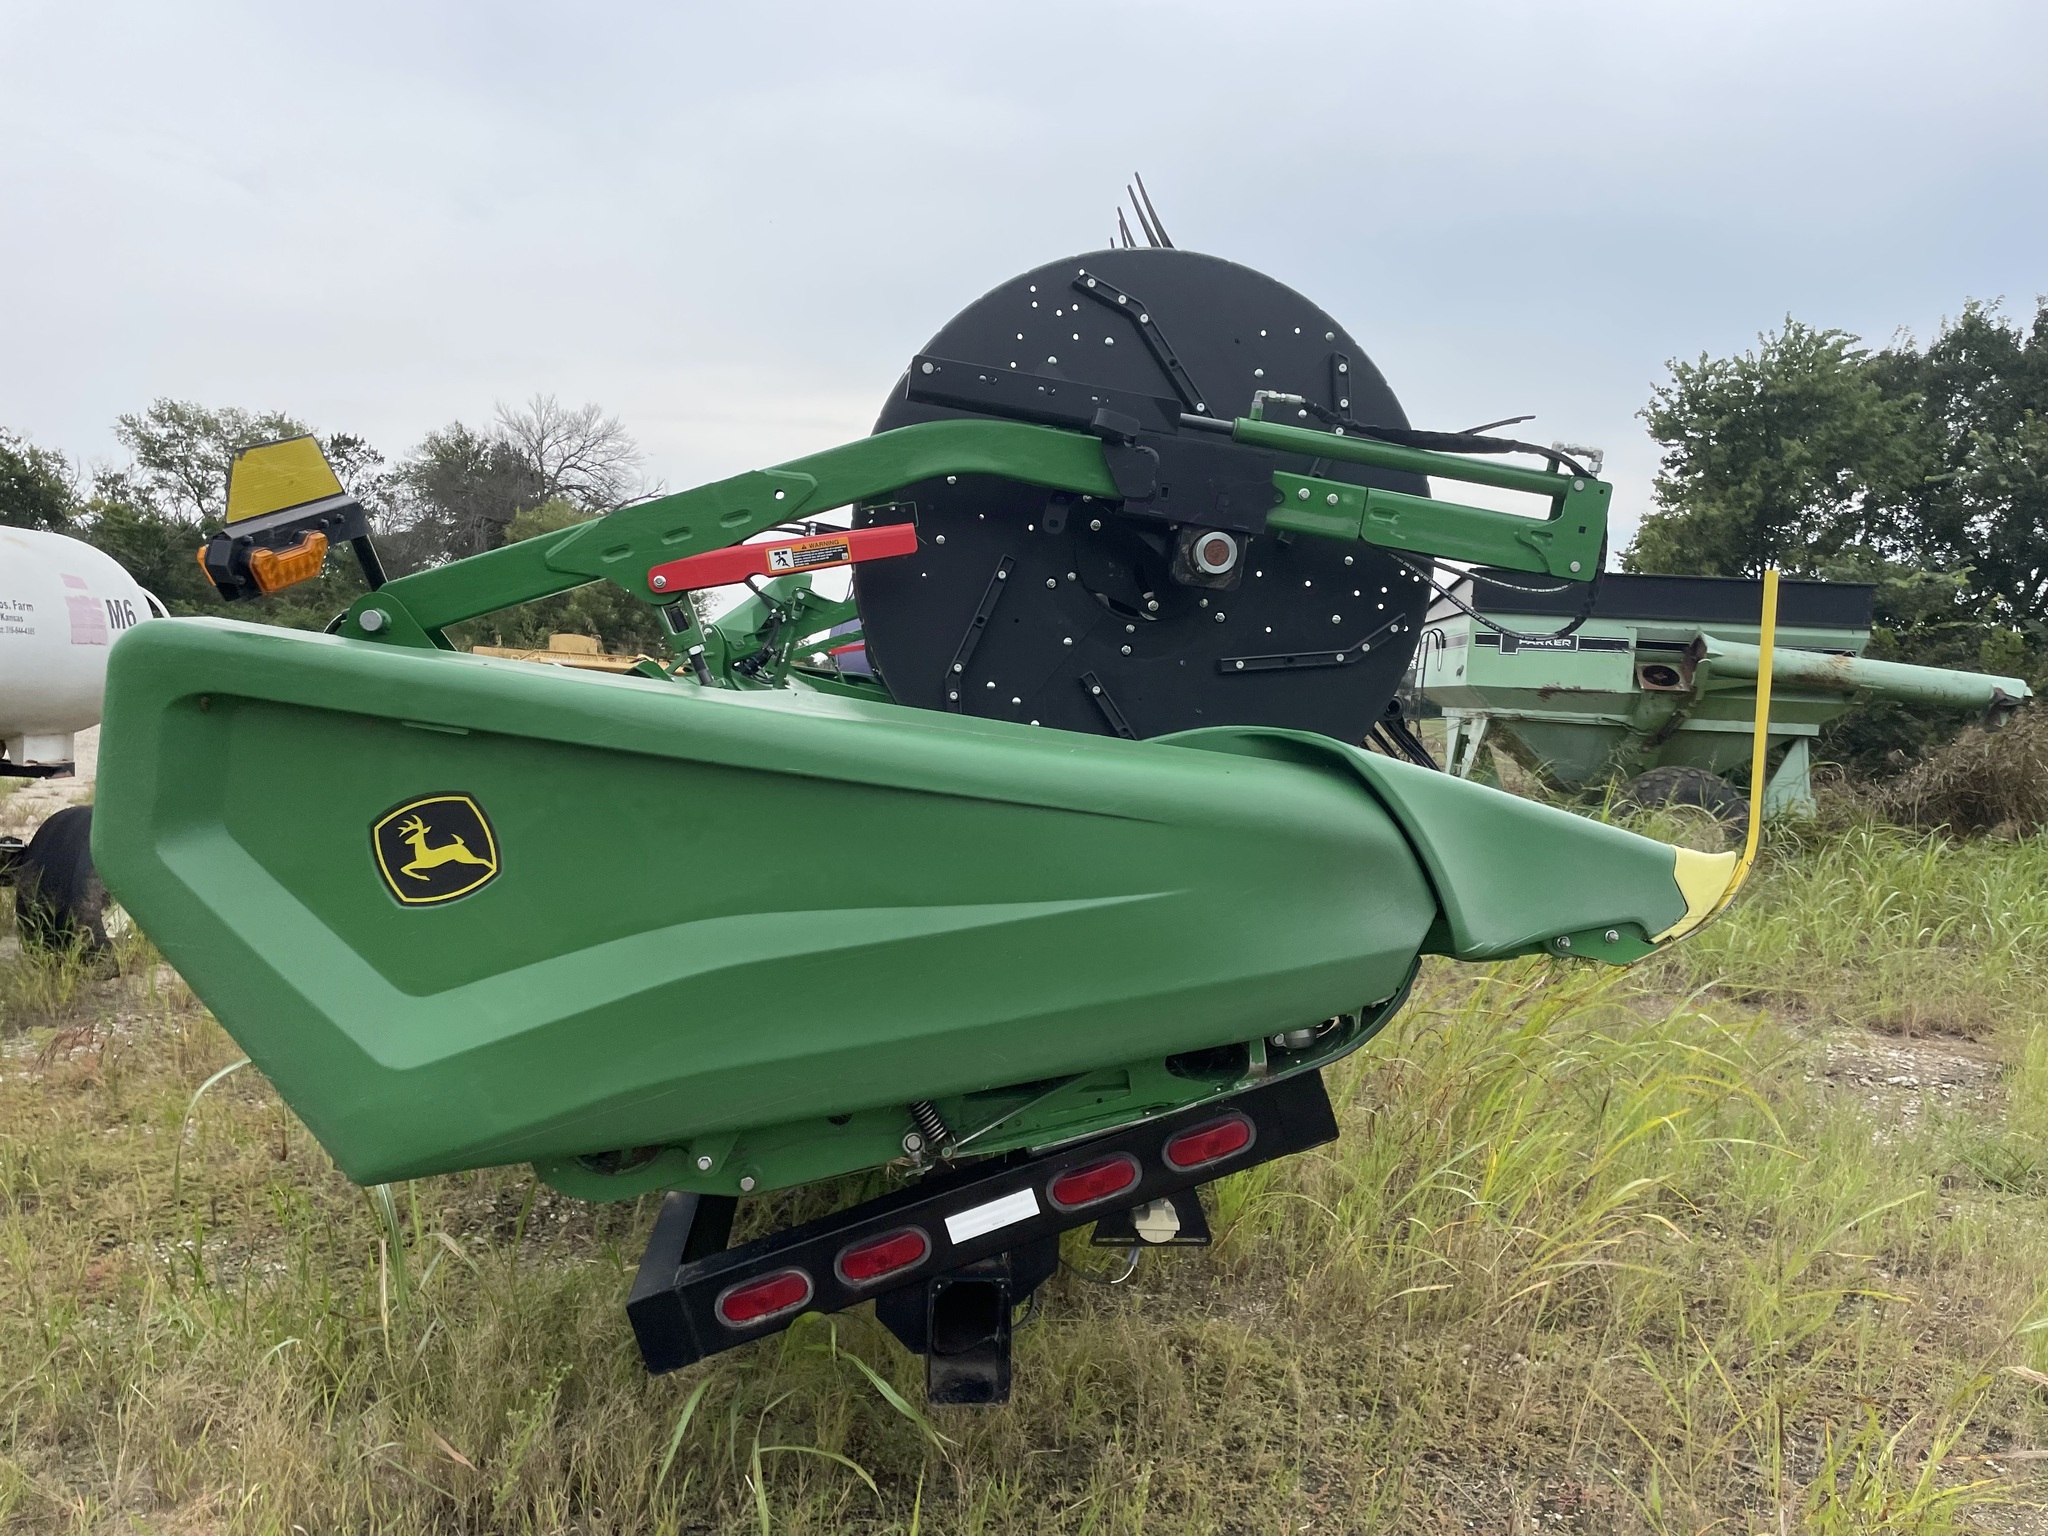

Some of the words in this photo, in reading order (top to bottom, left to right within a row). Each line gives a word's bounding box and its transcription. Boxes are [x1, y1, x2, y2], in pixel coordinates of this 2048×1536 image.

[809, 540, 839, 548] WARNING
[12, 600, 34, 611] Farm
[105, 599, 137, 629] M6
